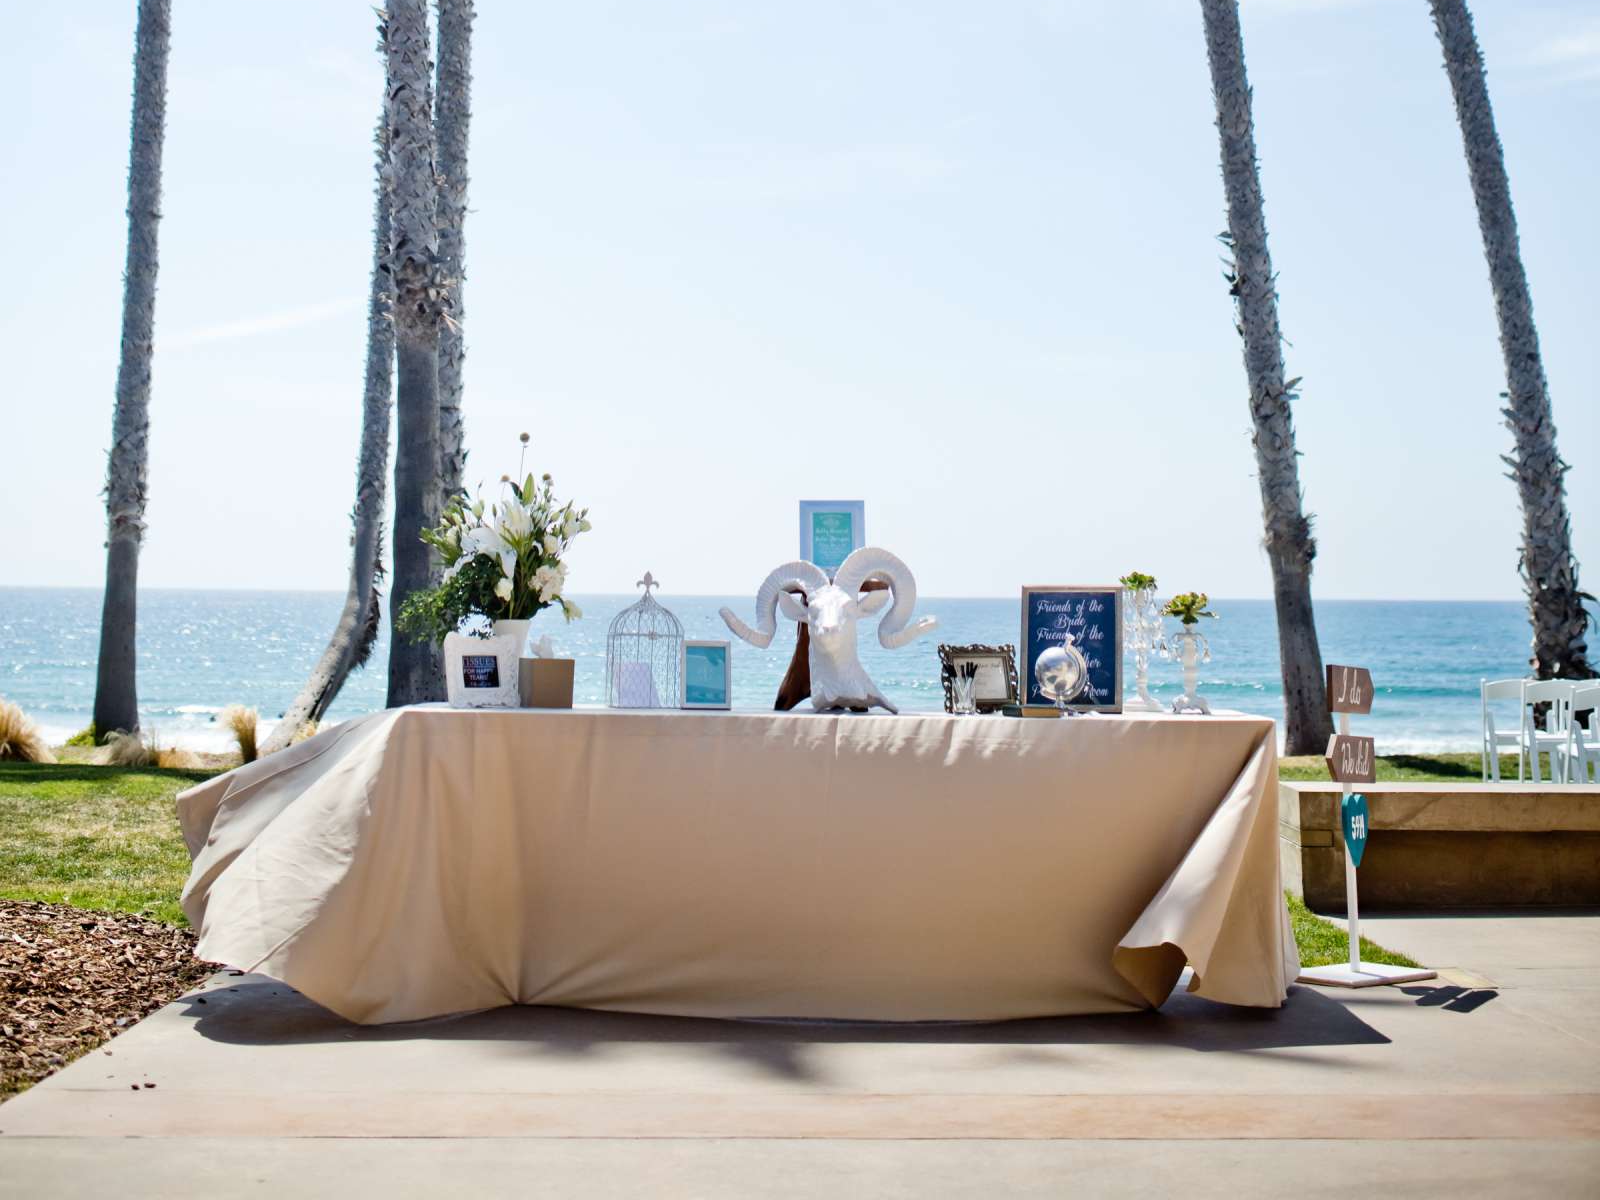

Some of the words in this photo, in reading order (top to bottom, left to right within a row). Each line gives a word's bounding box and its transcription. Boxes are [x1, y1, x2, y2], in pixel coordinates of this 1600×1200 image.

[1037, 599, 1071, 615] Friends
[1076, 599, 1086, 618] of
[1088, 599, 1104, 613] the
[1054, 613, 1086, 629] Bride
[1037, 625, 1071, 642] Friend
[1076, 625, 1086, 645] of
[1088, 624, 1105, 640] the
[1337, 667, 1348, 703] I
[1349, 668, 1362, 705] do
[1340, 742, 1355, 777] We
[1354, 741, 1370, 777] did
